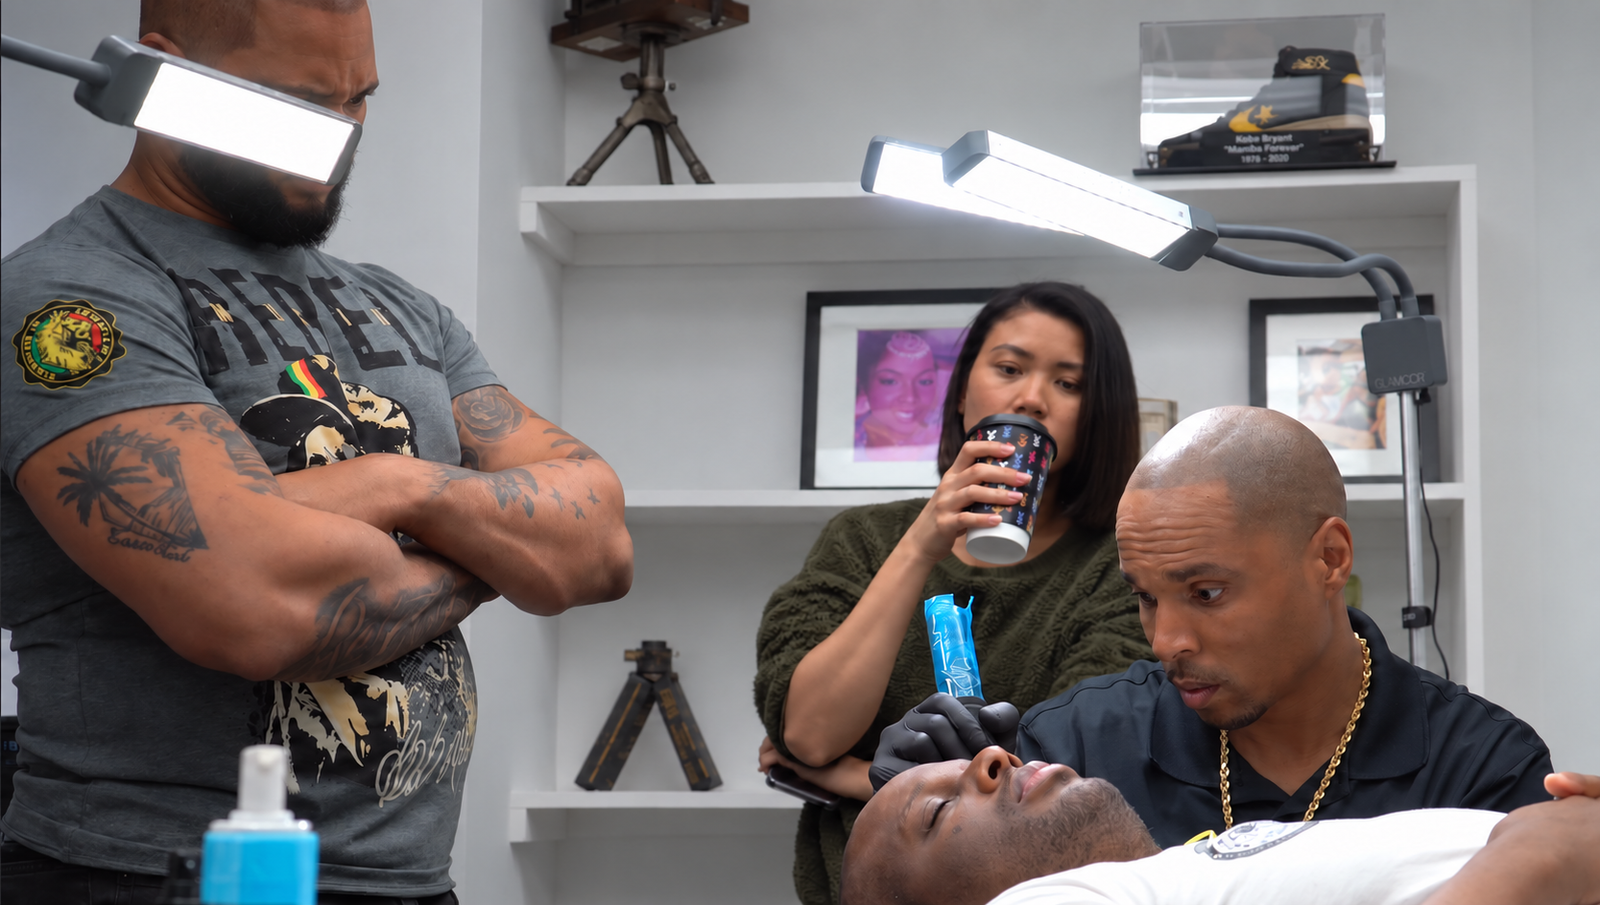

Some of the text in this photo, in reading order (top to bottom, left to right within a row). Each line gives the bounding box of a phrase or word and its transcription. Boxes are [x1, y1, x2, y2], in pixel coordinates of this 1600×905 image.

[1235, 133, 1293, 144] Kobe Bryant
[1223, 143, 1304, 153] "Mamba Forever"
[1268, 153, 1290, 163] 2020
[1374, 371, 1425, 389] GLAMCOR
